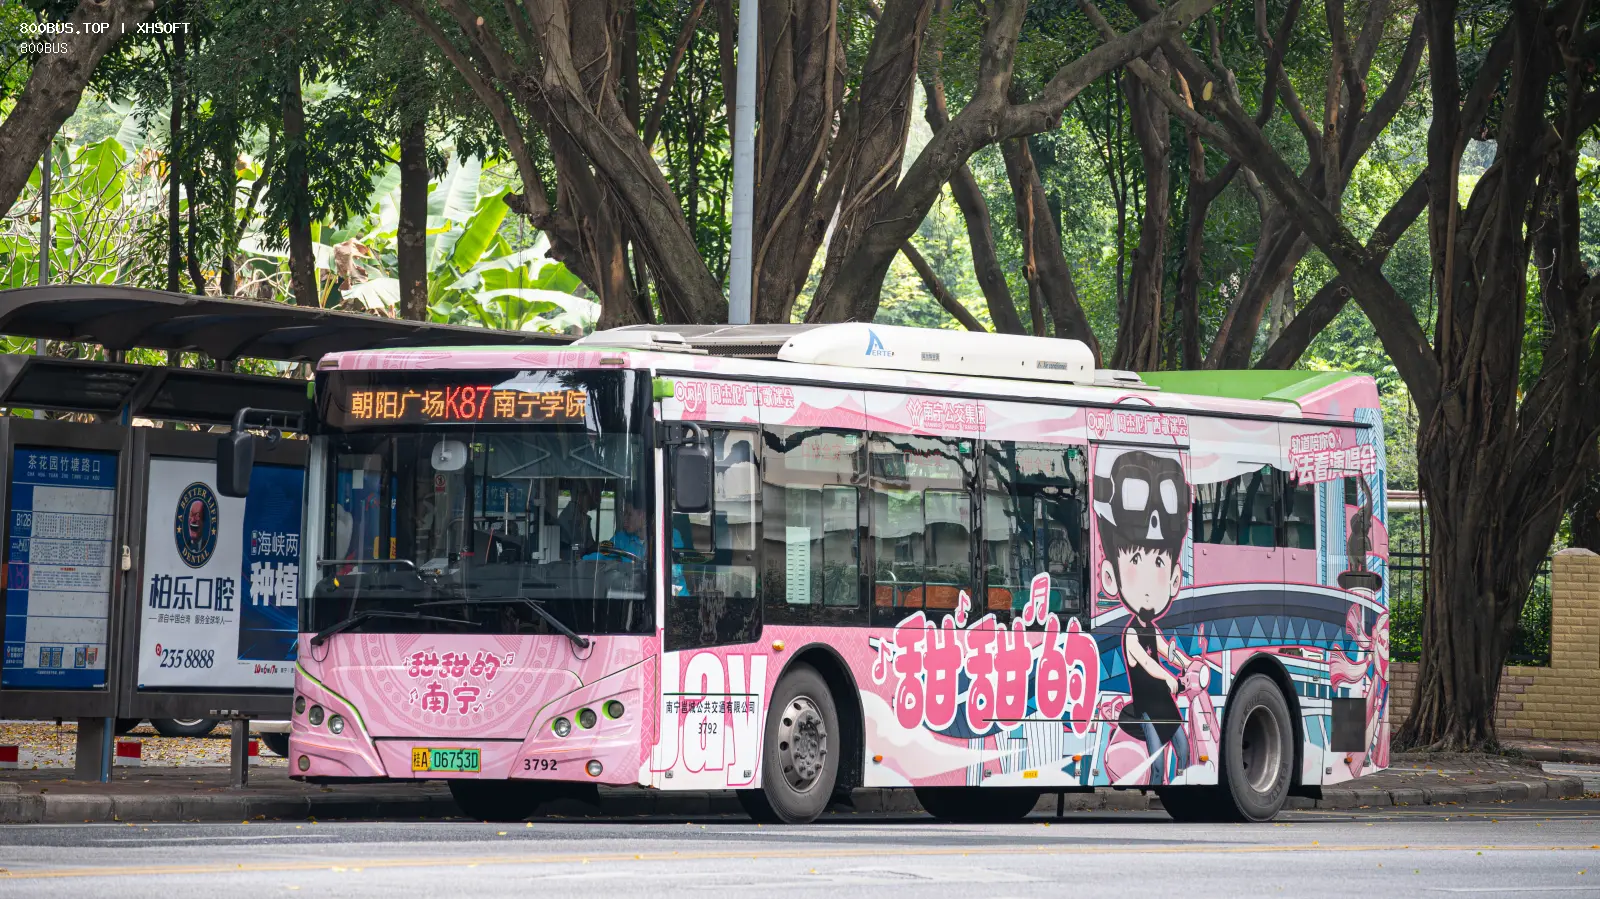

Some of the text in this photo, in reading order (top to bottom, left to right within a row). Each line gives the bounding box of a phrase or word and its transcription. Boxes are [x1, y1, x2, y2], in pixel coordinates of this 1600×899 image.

[351, 386, 587, 419] 朝阳广场 K87 南宁学院
[922, 400, 987, 425] 南宁公交集团
[28, 454, 101, 473] 茶花园竹塘路口
[181, 487, 207, 509] BETTER
[182, 547, 210, 563] DENTAL
[257, 531, 300, 557] 海峡两
[149, 574, 235, 612] 柏乐口腔
[250, 561, 299, 607] 种植
[158, 614, 226, 625] 源自中国台湾 服务全球华人
[407, 651, 501, 681] 甜甜的
[892, 610, 1100, 739] 甜甜的
[420, 680, 481, 715] 南宁
[665, 700, 755, 714] 南宁邕城公共交通有限公司
[698, 722, 718, 735] 3792
[434, 751, 479, 769] 06753D
[523, 758, 558, 771] 3792
